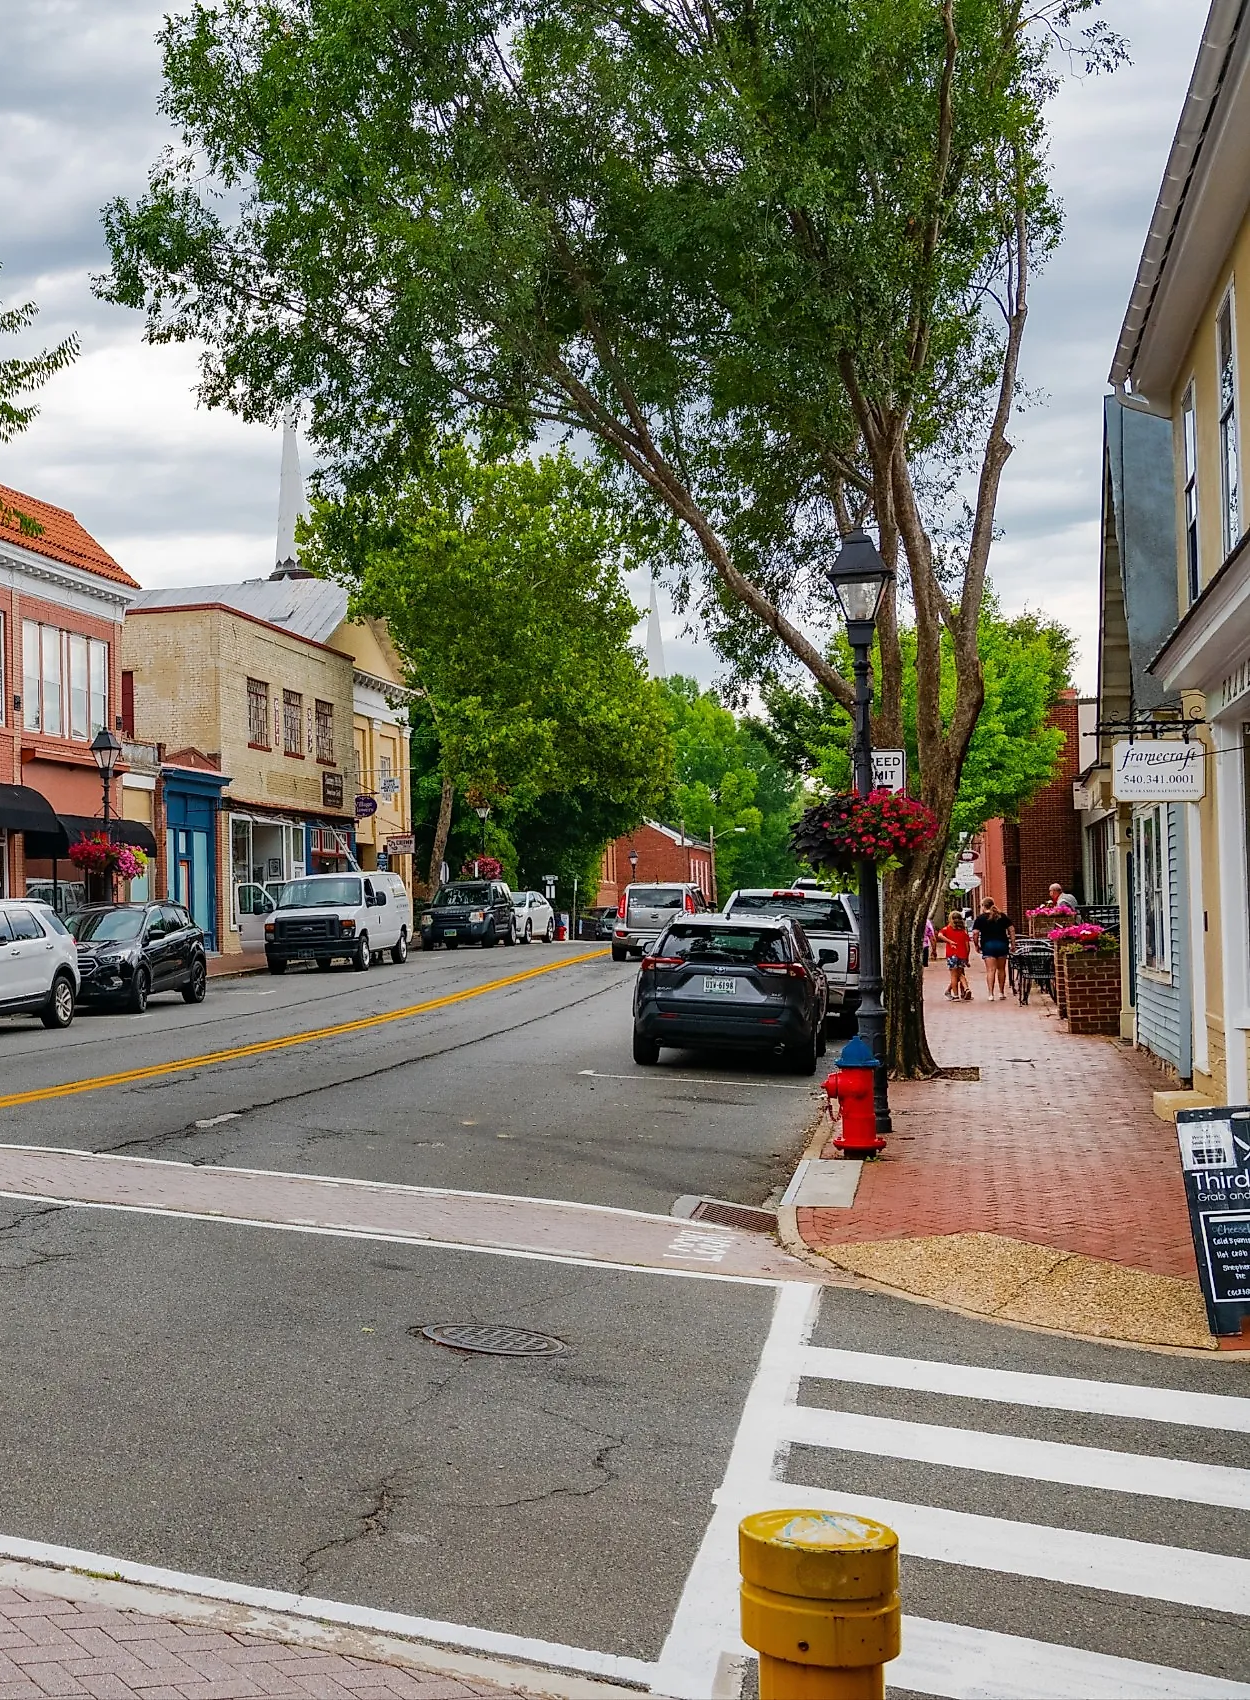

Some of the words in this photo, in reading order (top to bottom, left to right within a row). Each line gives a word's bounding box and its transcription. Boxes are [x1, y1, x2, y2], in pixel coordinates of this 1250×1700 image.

[1116, 747, 1197, 772] framecraft
[1123, 775, 1194, 784] 540.341.0001
[1191, 1169, 1250, 1191] Third
[1197, 1193, 1226, 1202] Grab
